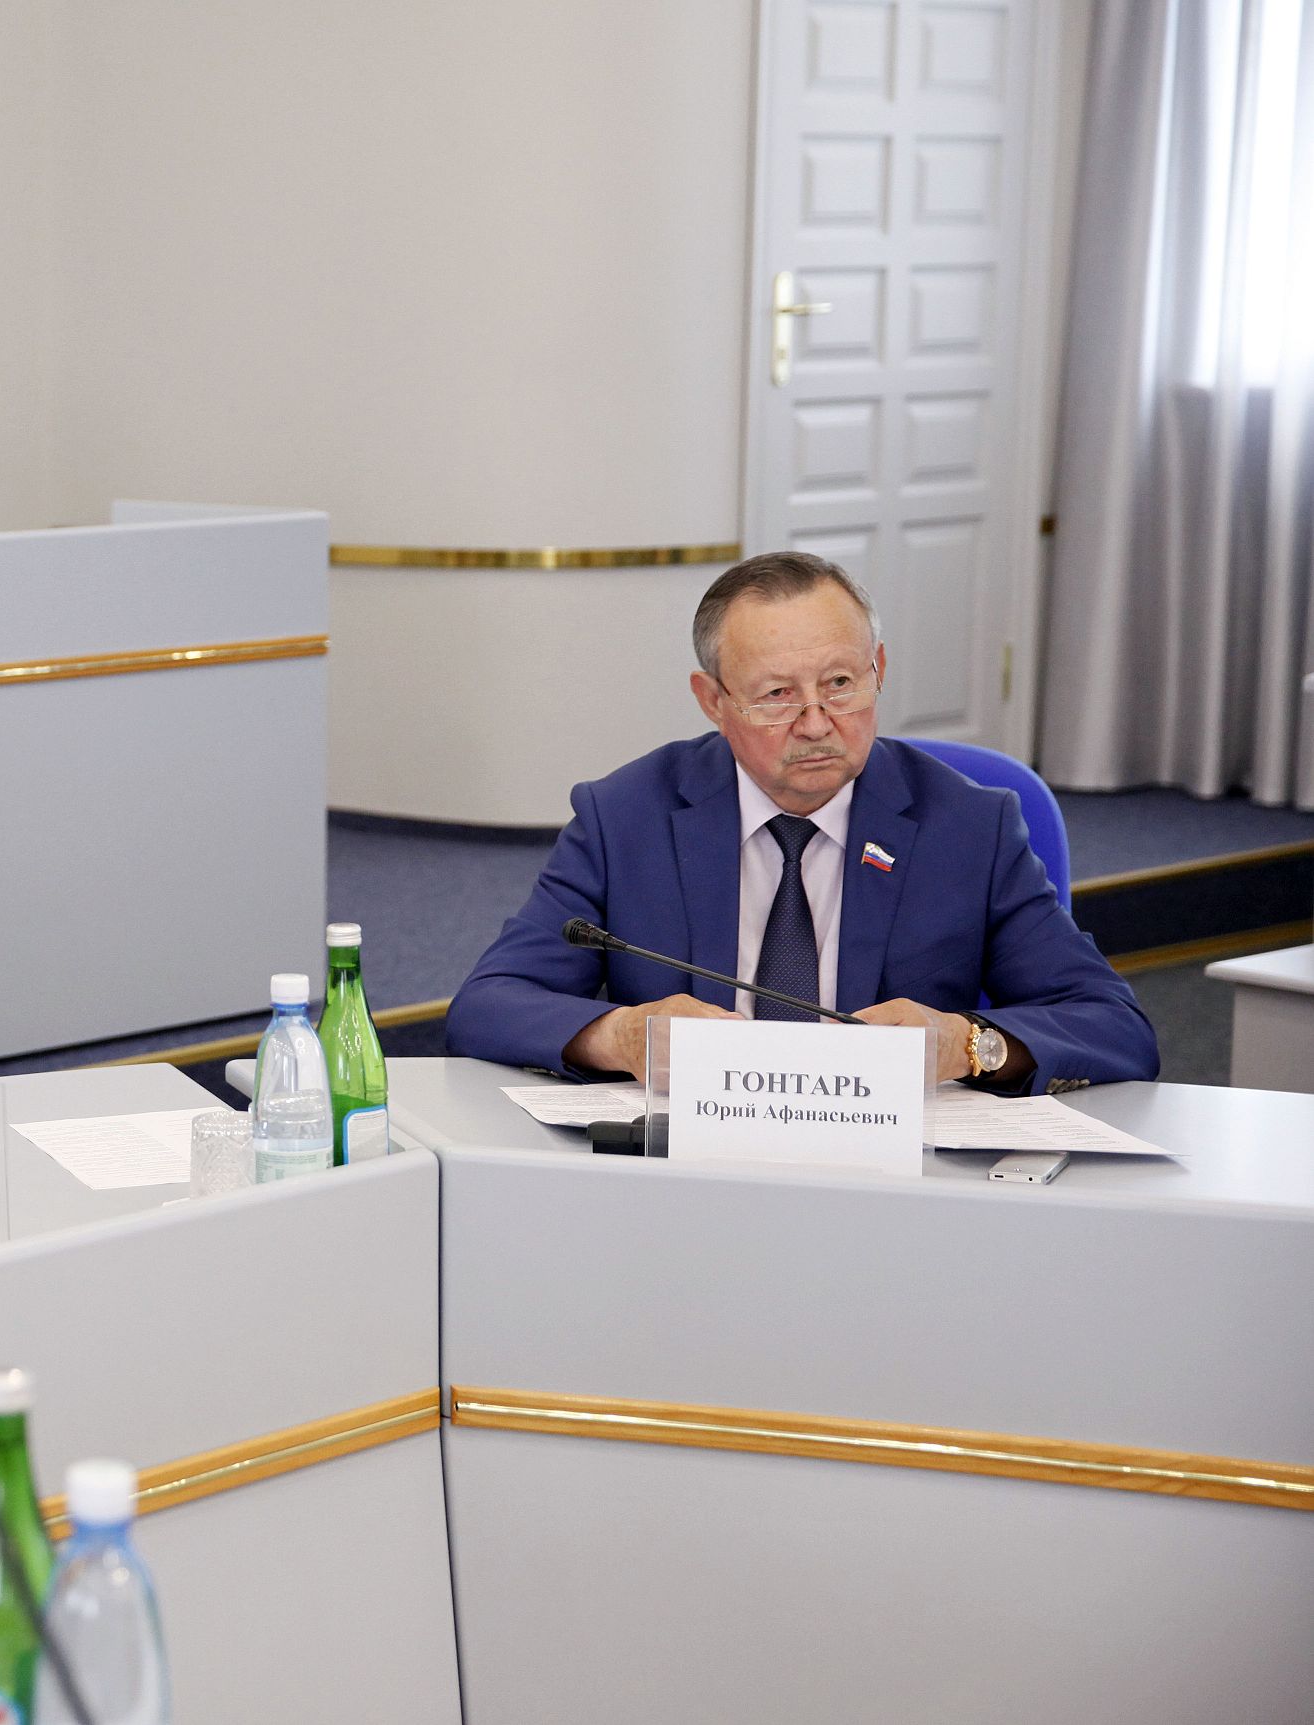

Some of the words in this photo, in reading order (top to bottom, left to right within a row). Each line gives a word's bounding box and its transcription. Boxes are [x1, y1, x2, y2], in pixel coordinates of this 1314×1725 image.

[722, 1070, 871, 1098] ГОНТАРЬ
[695, 1099, 756, 1120] Юрий
[763, 1103, 899, 1125] Афанасьевич
